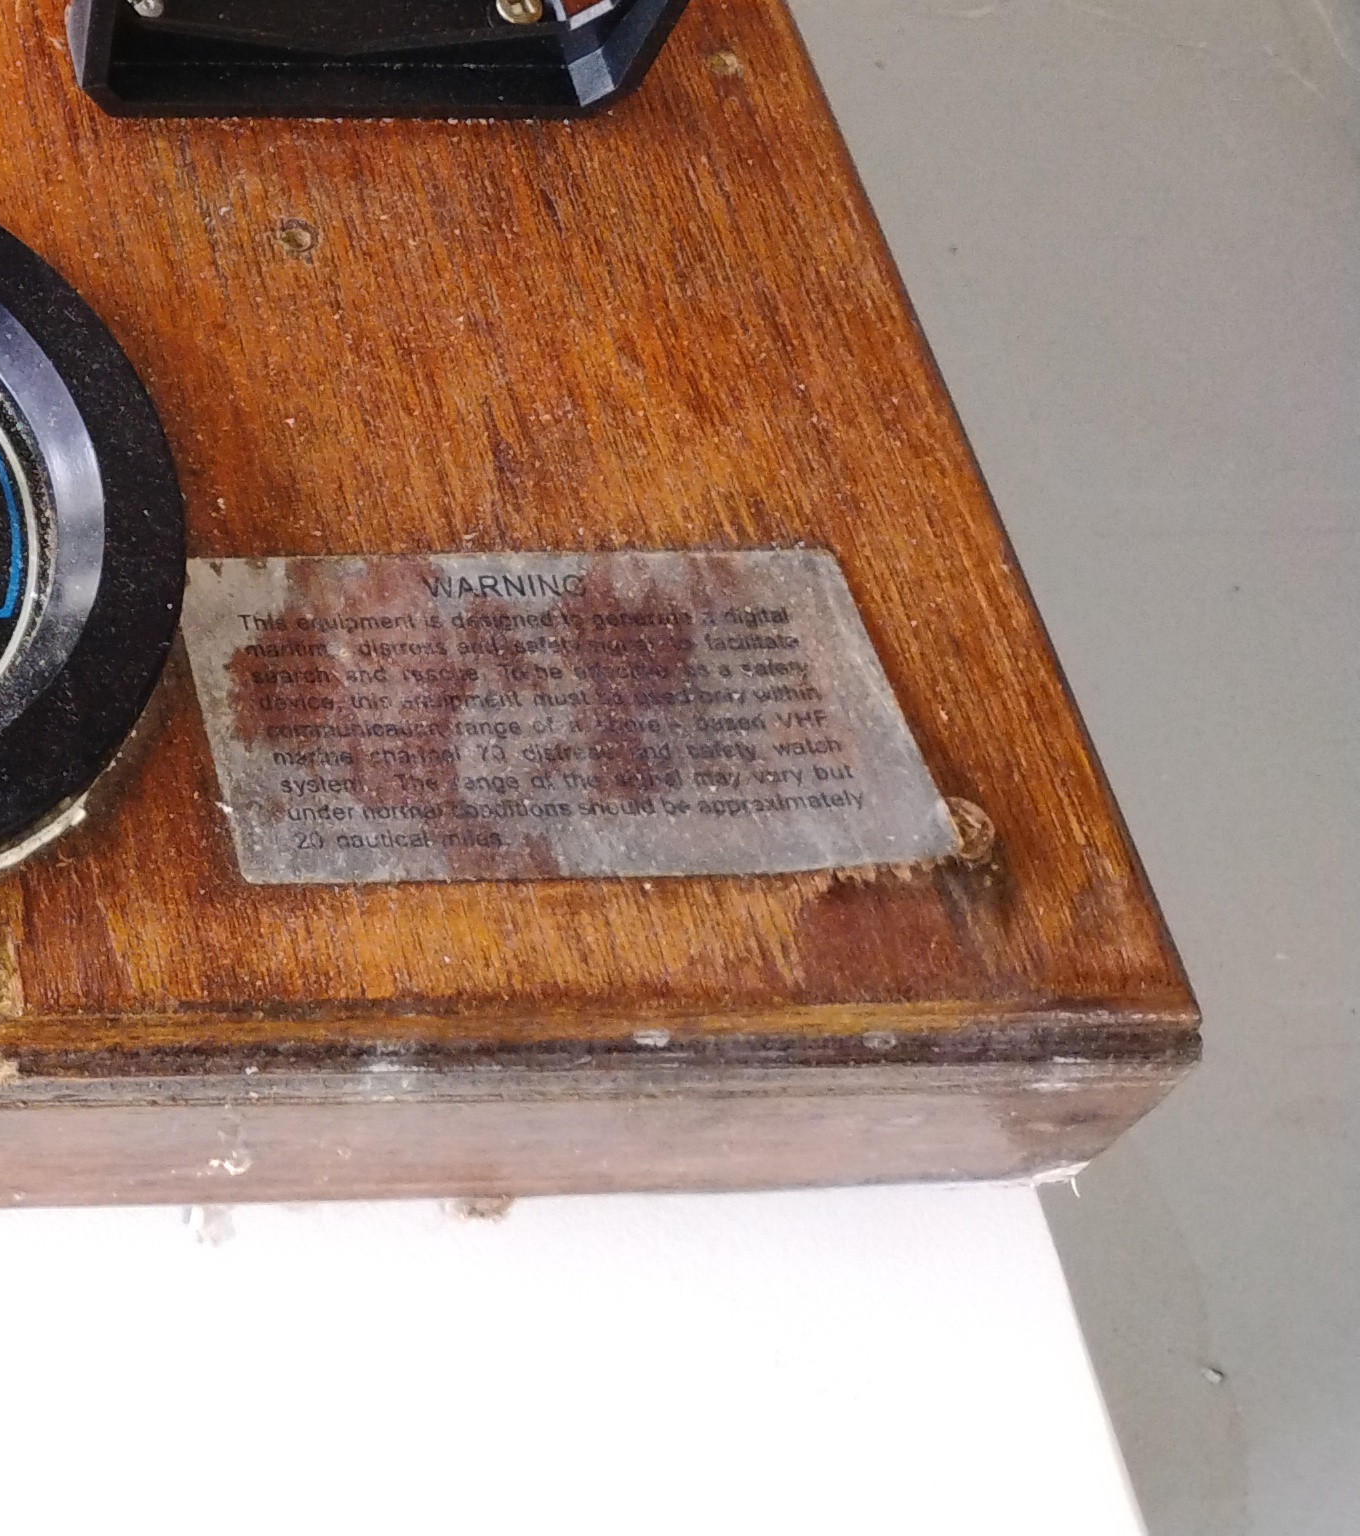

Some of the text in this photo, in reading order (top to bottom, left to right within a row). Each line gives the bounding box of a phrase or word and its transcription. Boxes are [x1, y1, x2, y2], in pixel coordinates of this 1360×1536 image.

[421, 573, 588, 600] WARNING
[237, 613, 288, 632] This
[296, 613, 416, 634] equipment
[250, 666, 330, 685] search
[346, 665, 388, 684] and
[532, 688, 587, 707] must
[774, 709, 827, 729] VHF
[772, 736, 843, 757] watch
[813, 763, 855, 781] but
[287, 803, 355, 822] under
[696, 789, 865, 817] approximately
[294, 830, 325, 851] 20
[335, 829, 431, 849] nautical
